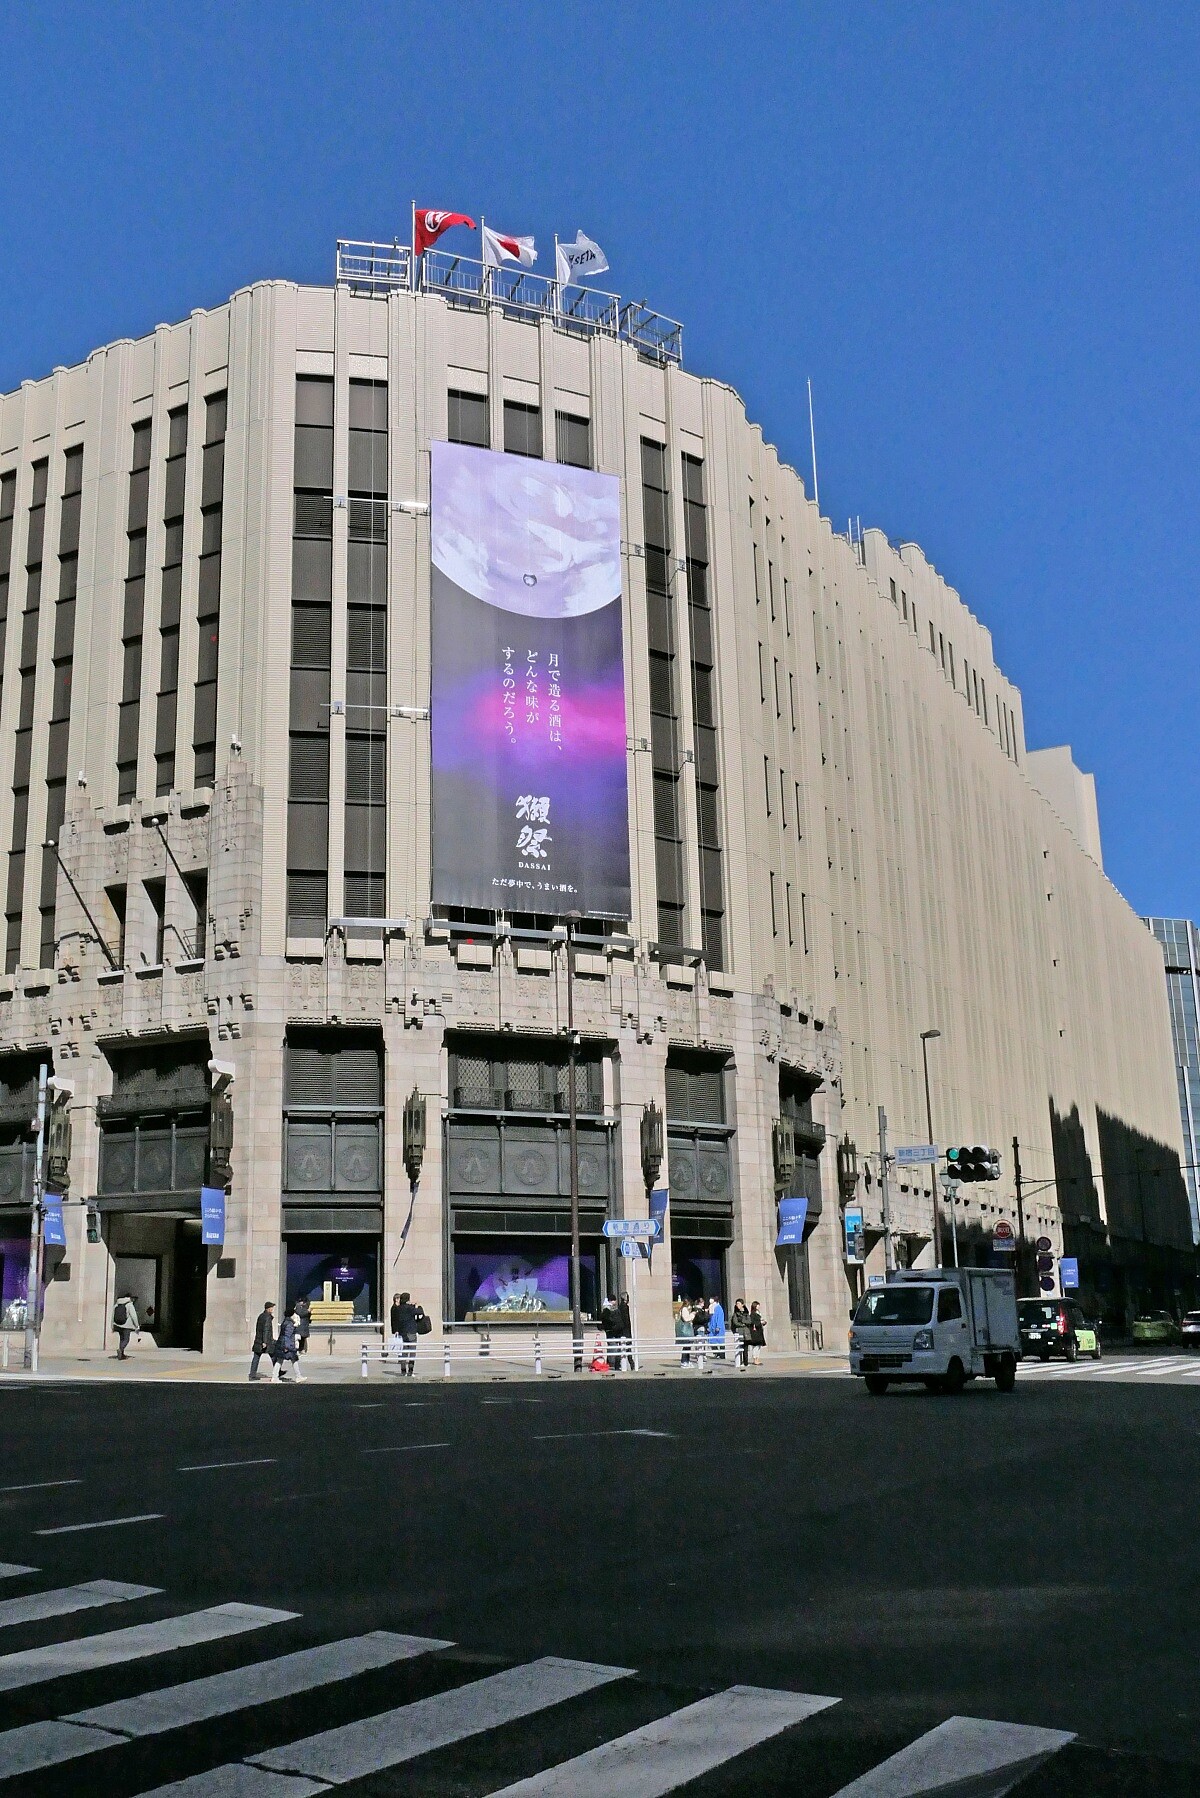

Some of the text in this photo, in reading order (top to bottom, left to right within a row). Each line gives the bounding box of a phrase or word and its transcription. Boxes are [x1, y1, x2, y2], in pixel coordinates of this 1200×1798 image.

[501, 646, 517, 744] するのだろう。
[525, 649, 539, 724] どんな味が
[548, 653, 562, 750] 月で造る酒は、
[491, 877, 578, 893] ただ夢中で、うまい酒を。
[518, 861, 551, 871] DASSAI
